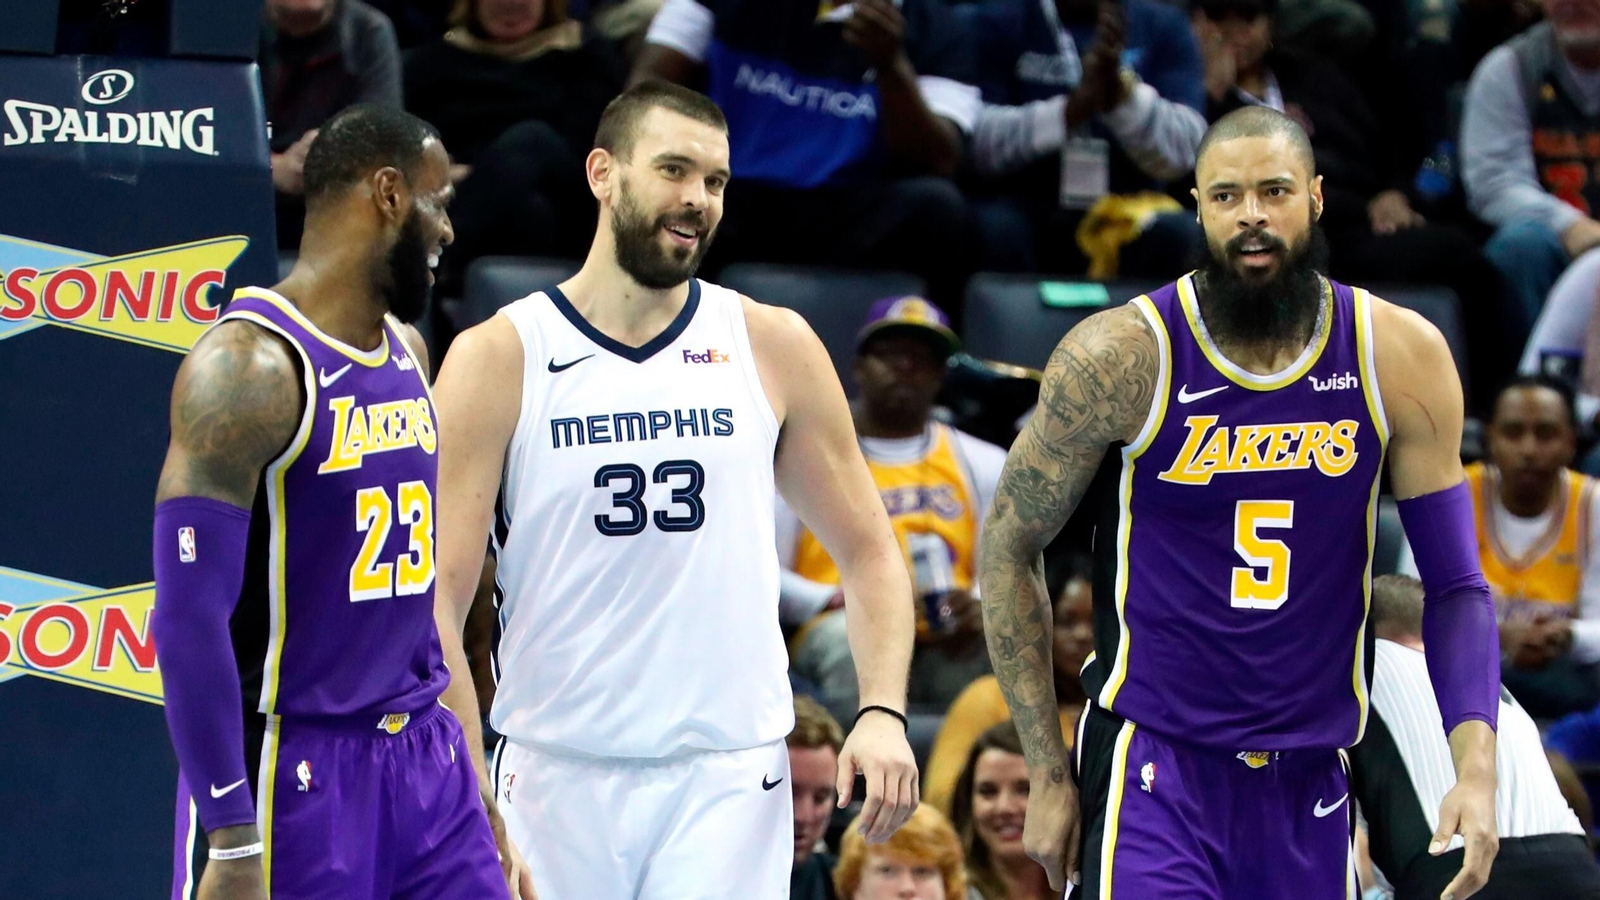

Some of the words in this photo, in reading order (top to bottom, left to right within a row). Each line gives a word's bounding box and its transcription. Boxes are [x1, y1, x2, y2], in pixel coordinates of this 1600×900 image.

[734, 64, 877, 122] NAUTICA
[4, 99, 214, 155] SPALDING
[0, 266, 227, 323] SONIC
[682, 348, 731, 364] FedEx
[1308, 371, 1359, 392] wish
[317, 395, 437, 475] LAKERS
[550, 408, 735, 449] MEMPHIS
[1157, 414, 1360, 486] LAKERS
[594, 459, 706, 537] 33
[349, 480, 436, 603] 23
[1230, 500, 1294, 610] 5
